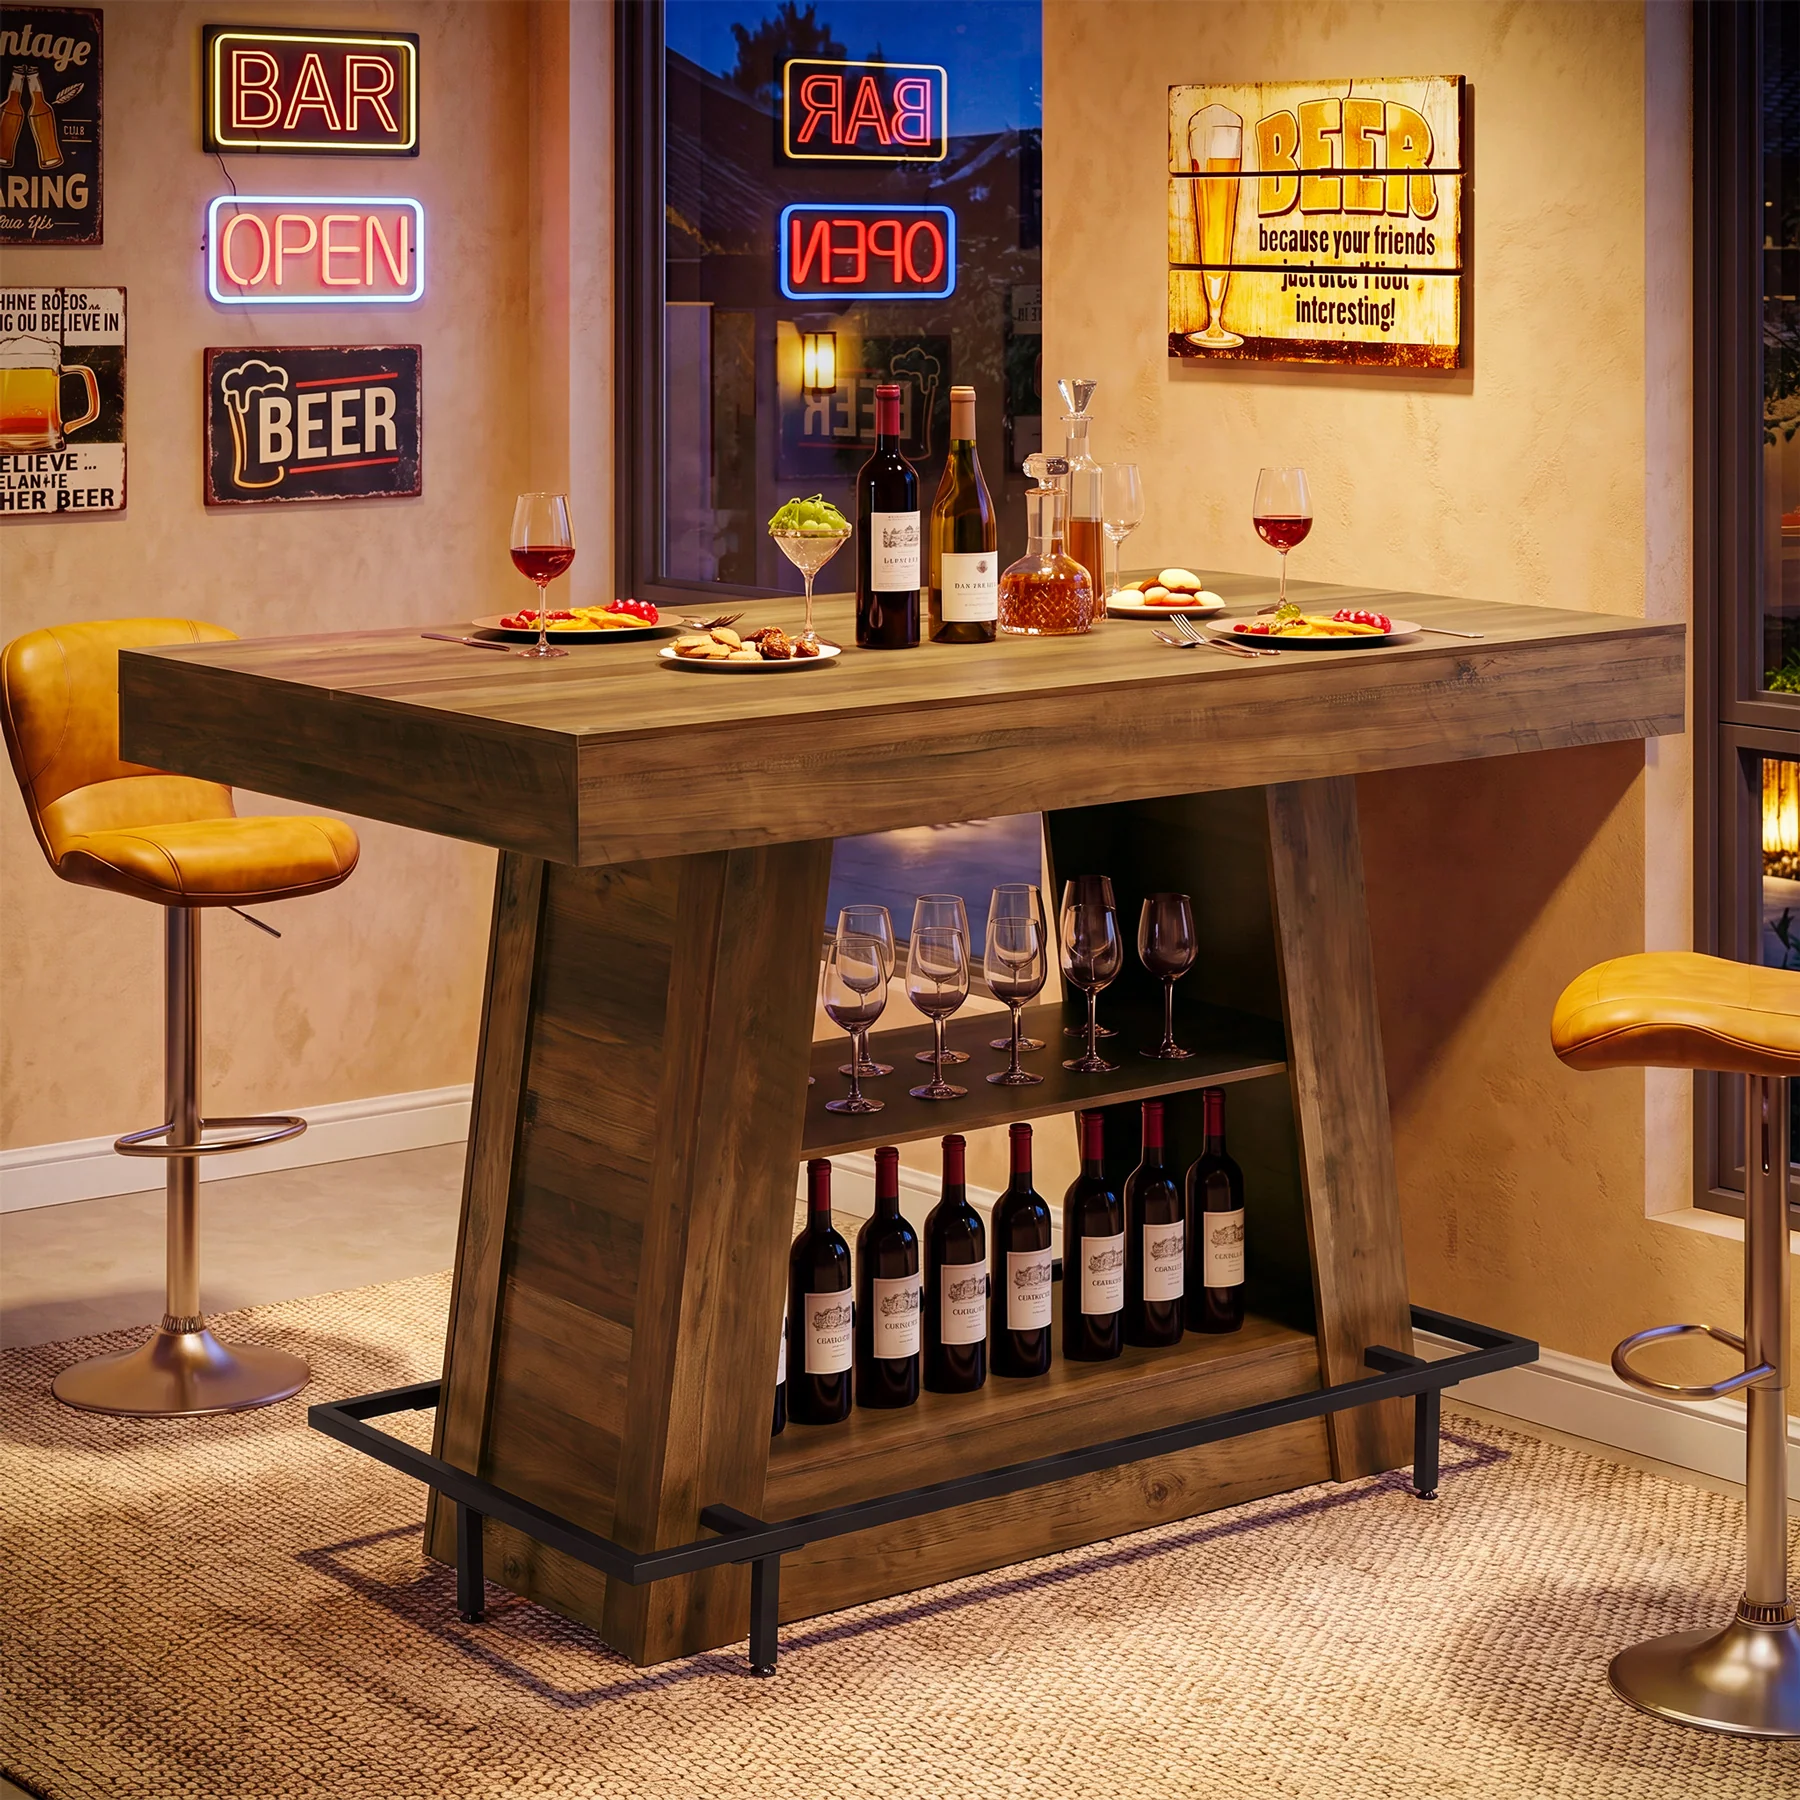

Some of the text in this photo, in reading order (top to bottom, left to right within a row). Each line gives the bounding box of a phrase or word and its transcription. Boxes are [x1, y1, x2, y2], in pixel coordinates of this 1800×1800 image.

[232, 50, 399, 132] BAR
[1255, 97, 1439, 221] BEER
[0, 173, 89, 210] RING
[222, 213, 408, 286] OPEN
[1258, 223, 1436, 260] because your friends
[41, 313, 100, 331] BELIEVE
[104, 312, 119, 331] IN
[1296, 293, 1396, 332] interesting!
[259, 386, 397, 464] BEER
[57, 488, 115, 510] BEER
